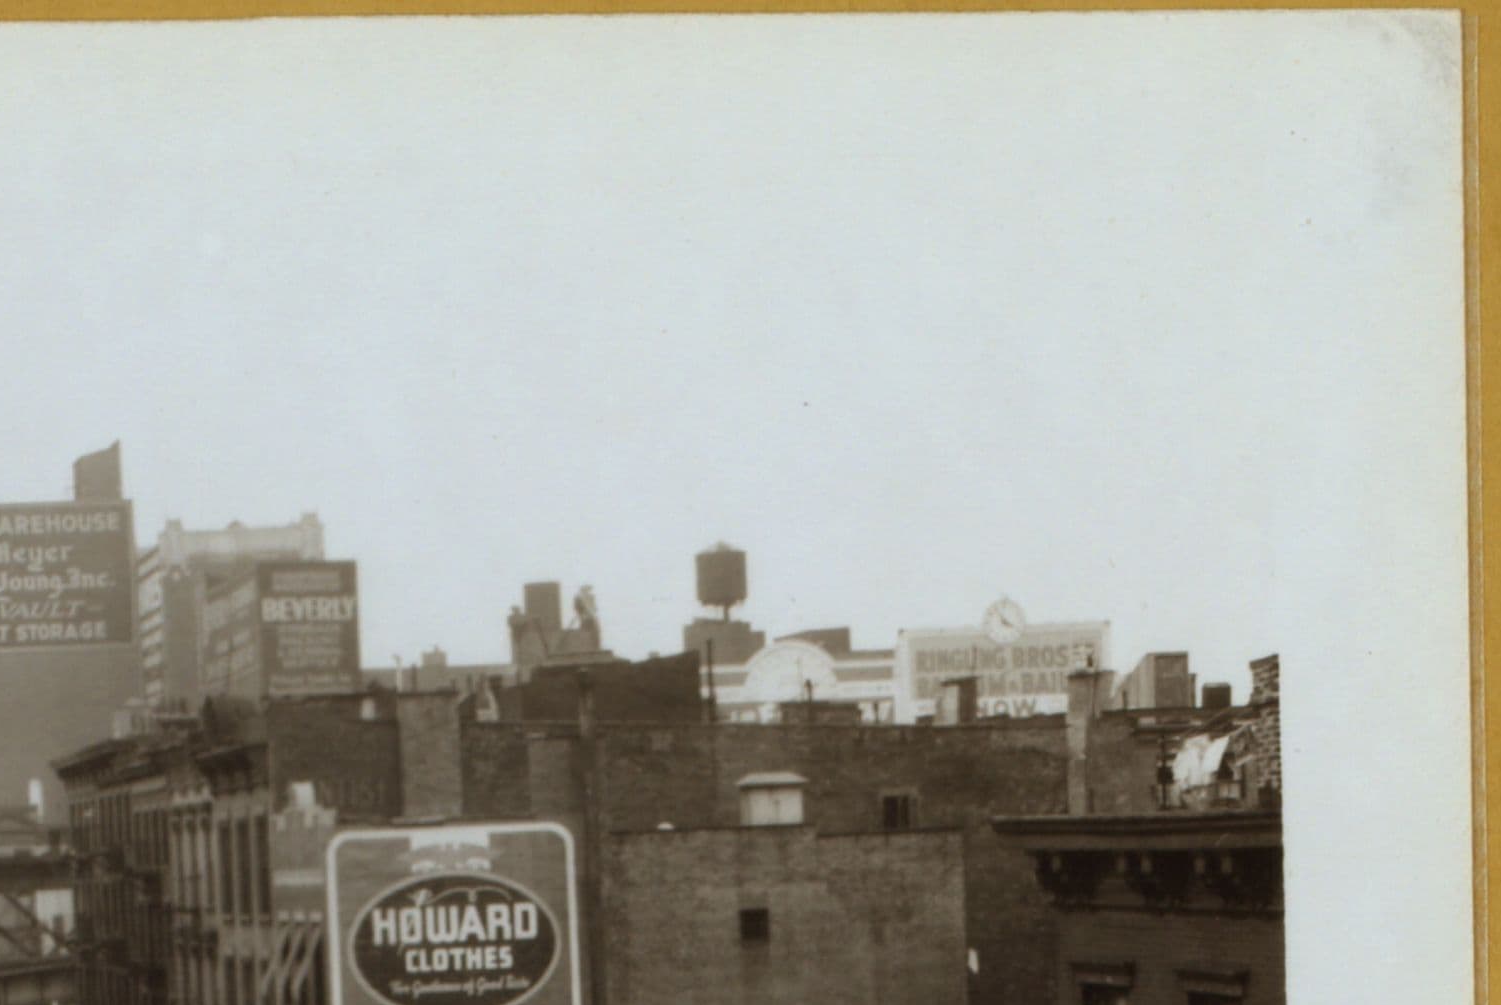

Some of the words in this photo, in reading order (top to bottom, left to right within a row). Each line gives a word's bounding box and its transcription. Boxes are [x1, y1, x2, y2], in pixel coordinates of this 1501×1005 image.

[261, 597, 356, 622] BEVERLY
[15, 621, 109, 643] STORAGE
[372, 902, 539, 947] HOWARD
[405, 946, 514, 973] CLOTHES
